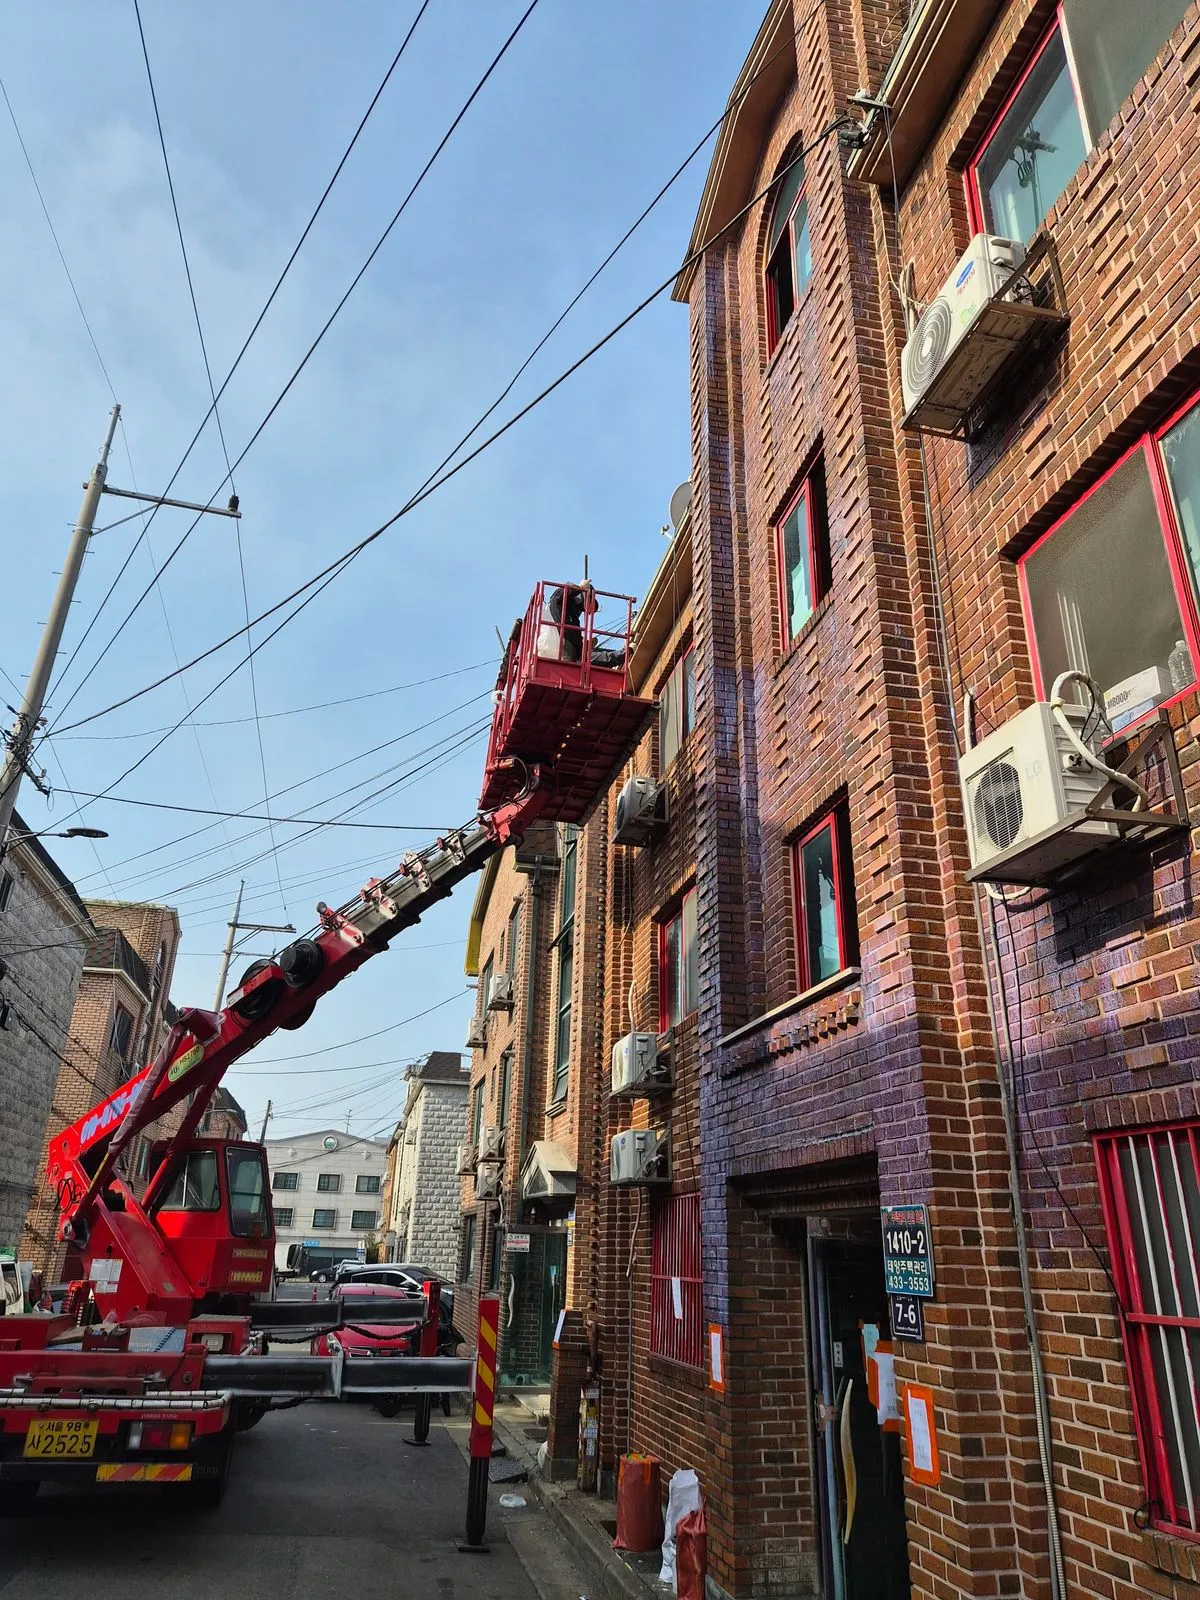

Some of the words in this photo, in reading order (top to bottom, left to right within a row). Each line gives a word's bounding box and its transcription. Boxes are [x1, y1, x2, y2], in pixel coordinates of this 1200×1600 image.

[1025, 760, 1042, 780] LG
[886, 1230, 926, 1254] 1410-2
[887, 1260, 927, 1274] 태양주택관리
[888, 1276, 929, 1291] 433-3553
[895, 1303, 916, 1325] 7-6
[46, 1422, 63, 1432] 서울
[66, 1421, 82, 1432] 98
